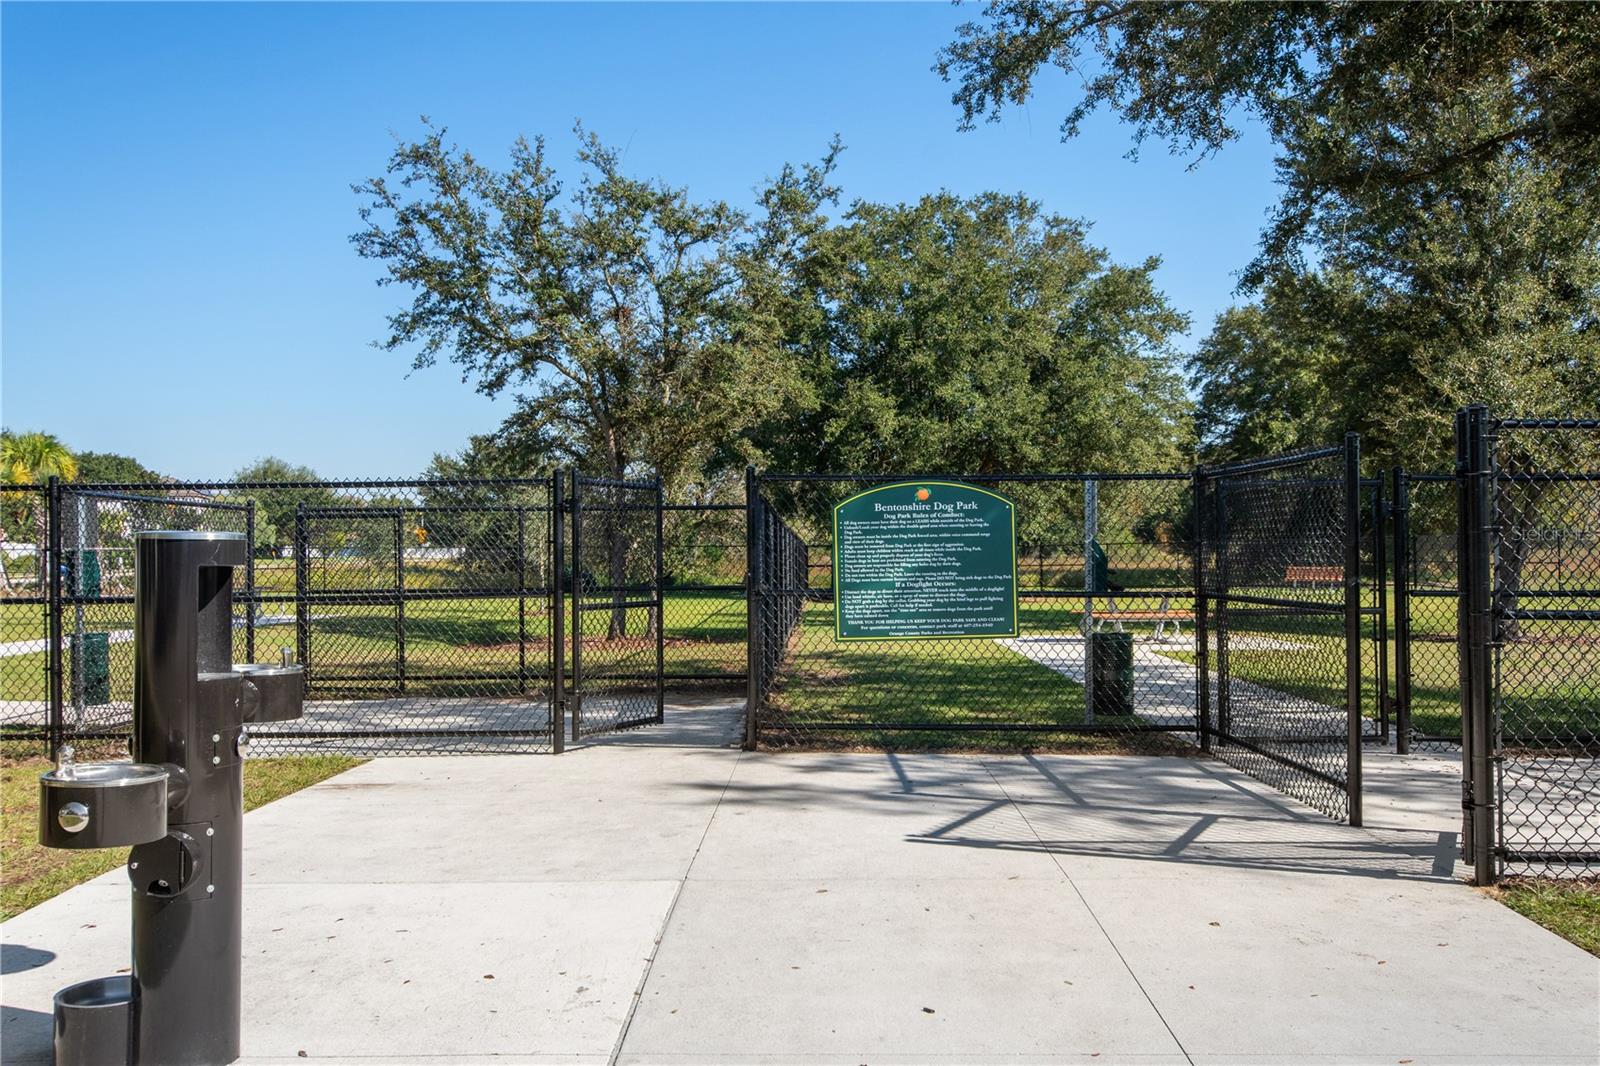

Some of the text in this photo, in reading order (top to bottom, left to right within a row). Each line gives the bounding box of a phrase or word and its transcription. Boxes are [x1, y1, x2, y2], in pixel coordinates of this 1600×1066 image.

[875, 501, 978, 513] Bentonshire Dog Park
